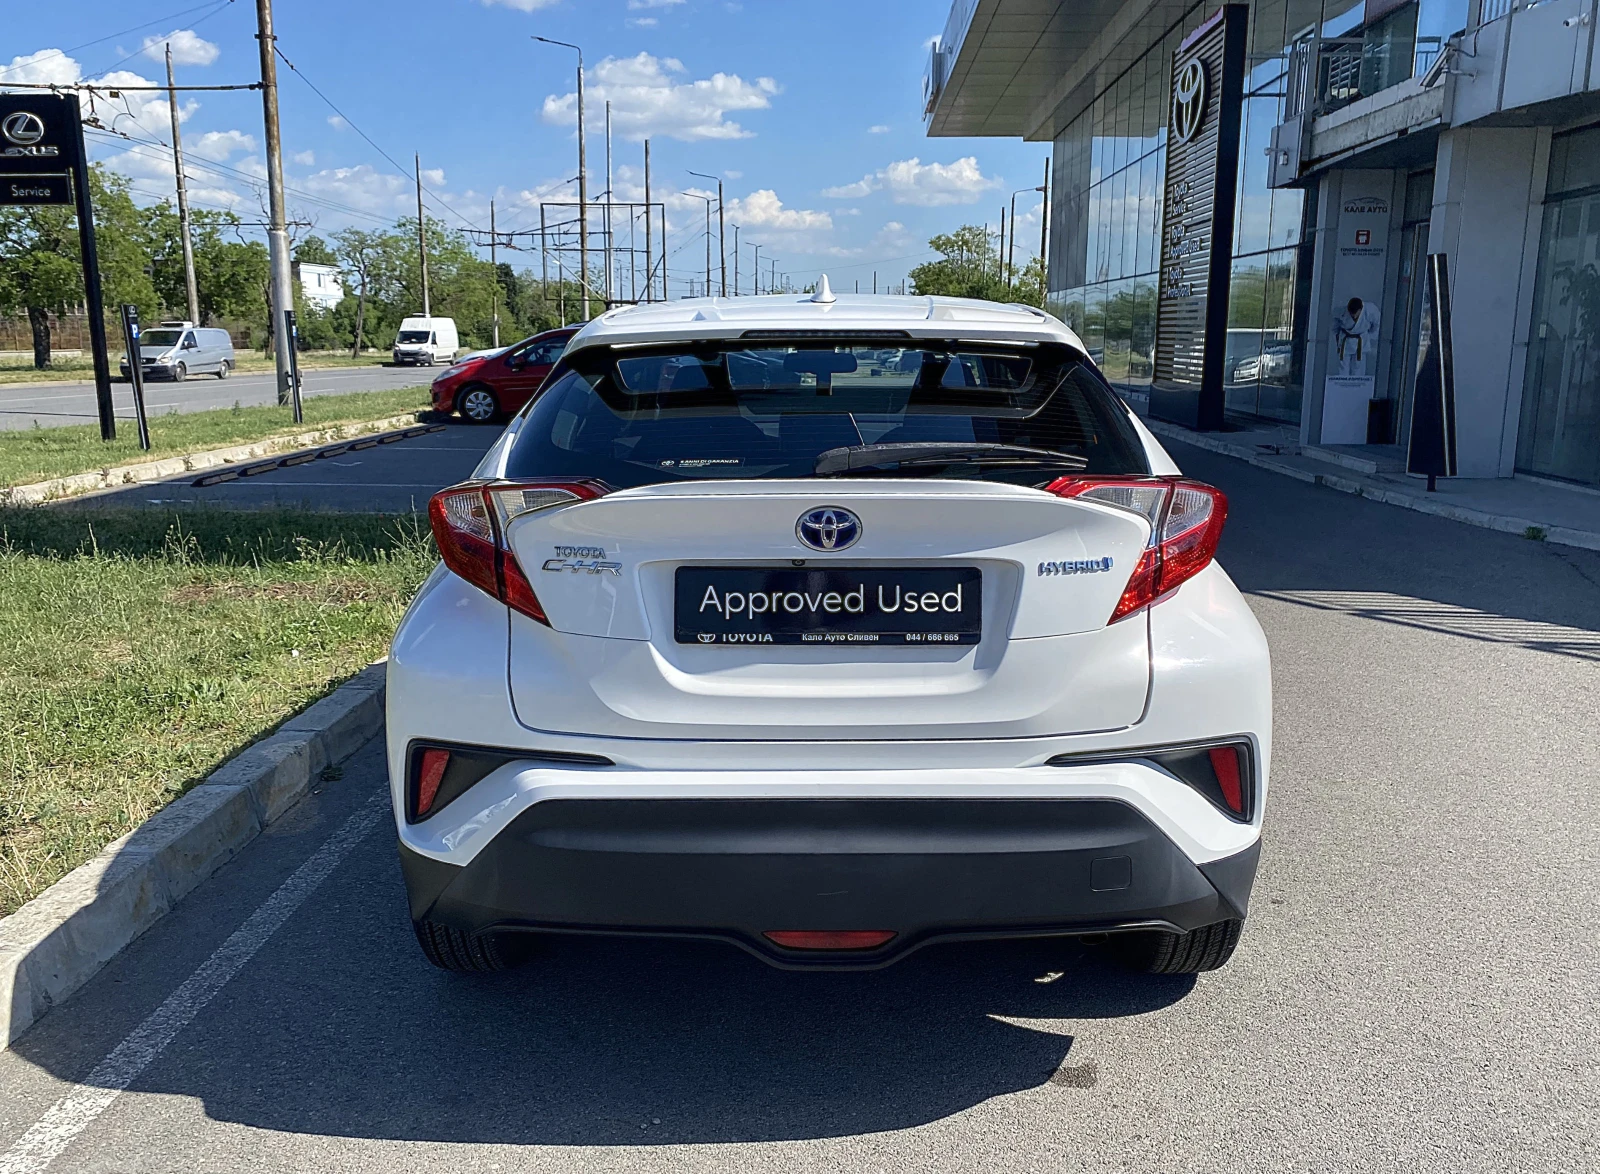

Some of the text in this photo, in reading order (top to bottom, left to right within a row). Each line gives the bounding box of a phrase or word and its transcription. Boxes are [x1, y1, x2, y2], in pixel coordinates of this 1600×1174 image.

[0, 146, 59, 157] EXUS
[11, 184, 51, 197] Service
[131, 324, 138, 339] P
[554, 546, 607, 560] TOYOTA
[542, 559, 622, 576] C-HR
[1037, 559, 1104, 577] HYBRID
[699, 583, 963, 620] Approved Used
[824, 633, 845, 643] Ауто
[847, 633, 879, 641] Сливен
[906, 633, 921, 641] 044
